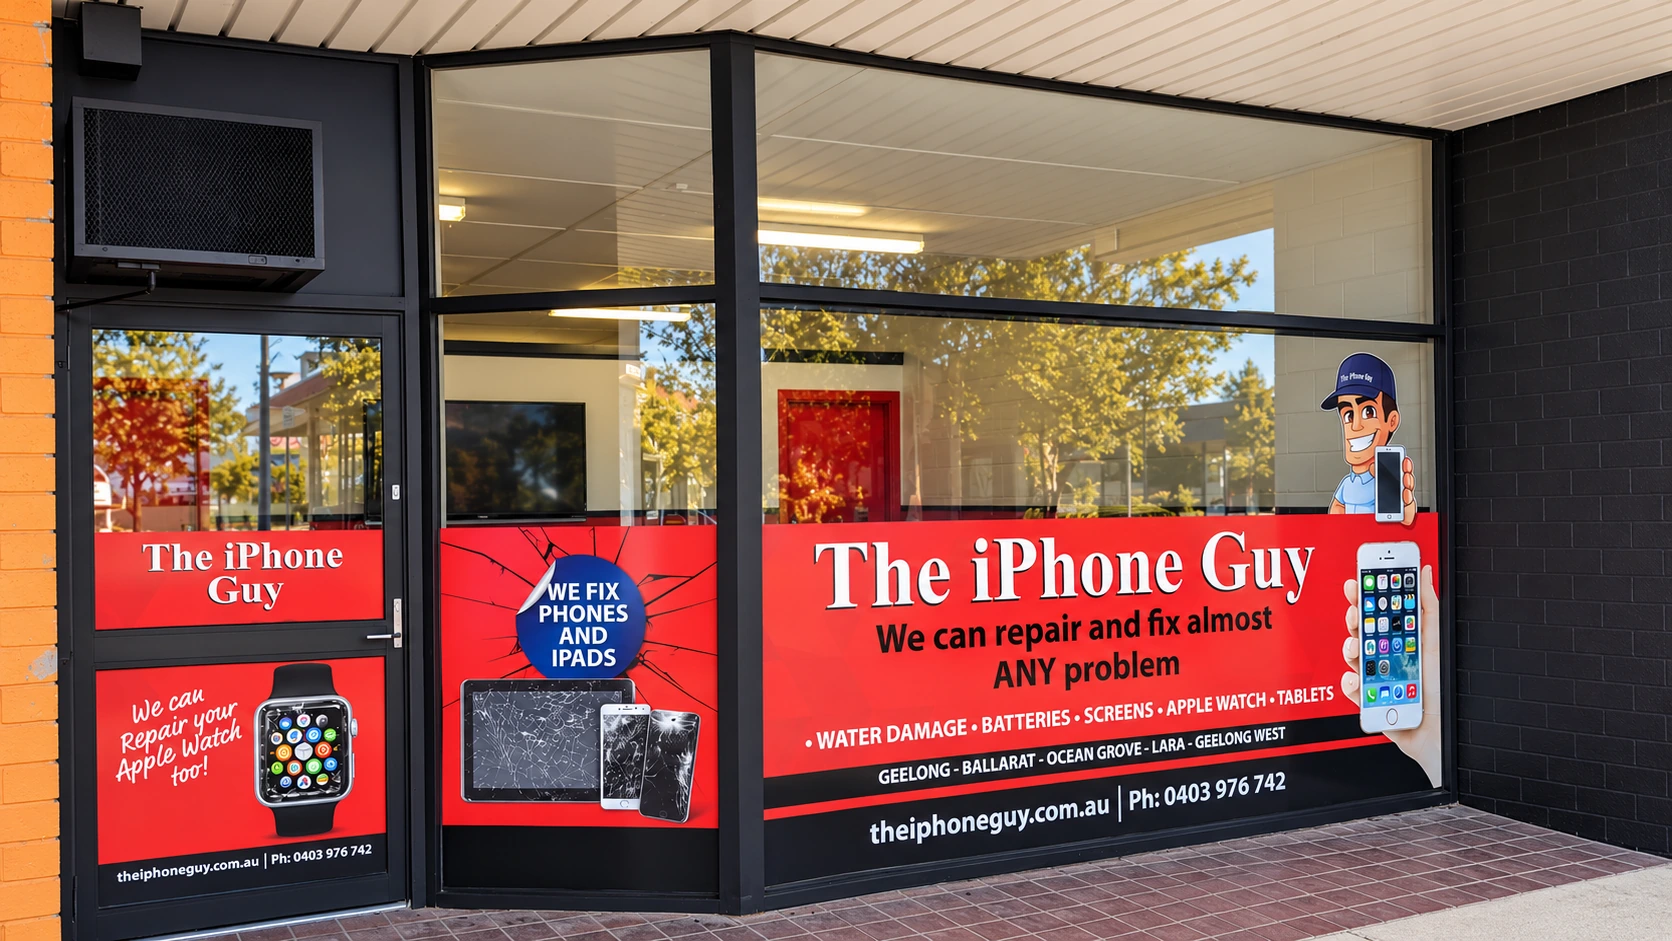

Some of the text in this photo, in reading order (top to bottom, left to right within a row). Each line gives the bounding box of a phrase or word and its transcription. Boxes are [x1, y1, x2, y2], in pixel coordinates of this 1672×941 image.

[142, 541, 344, 572] The iPhone
[815, 531, 1316, 609] The iPhone Guy
[208, 575, 285, 611] Guy
[547, 582, 621, 601] WE FIX
[539, 603, 629, 623] PHONES
[875, 605, 1273, 654] We can repair and fix almost
[558, 626, 608, 645] AND
[552, 648, 617, 667] IPADS
[993, 650, 1180, 691] ANY problem
[132, 688, 205, 724] We can
[815, 685, 1335, 750] WATER DAMAGE BATTERIES SCREENS APPLE WATCH TABLETS
[120, 702, 238, 753] Repair your
[115, 717, 242, 784] Apple Watch
[170, 754, 208, 787] too!
[878, 726, 1286, 785] GEELONG BALLARAT OCEAN GROVE LARA GEELONG WEST
[869, 771, 1286, 845] theiphoneguy.com.au Ph: 0403 976 742
[116, 843, 372, 883] theiphoneguy.com.au Ph: 0403 976 742
